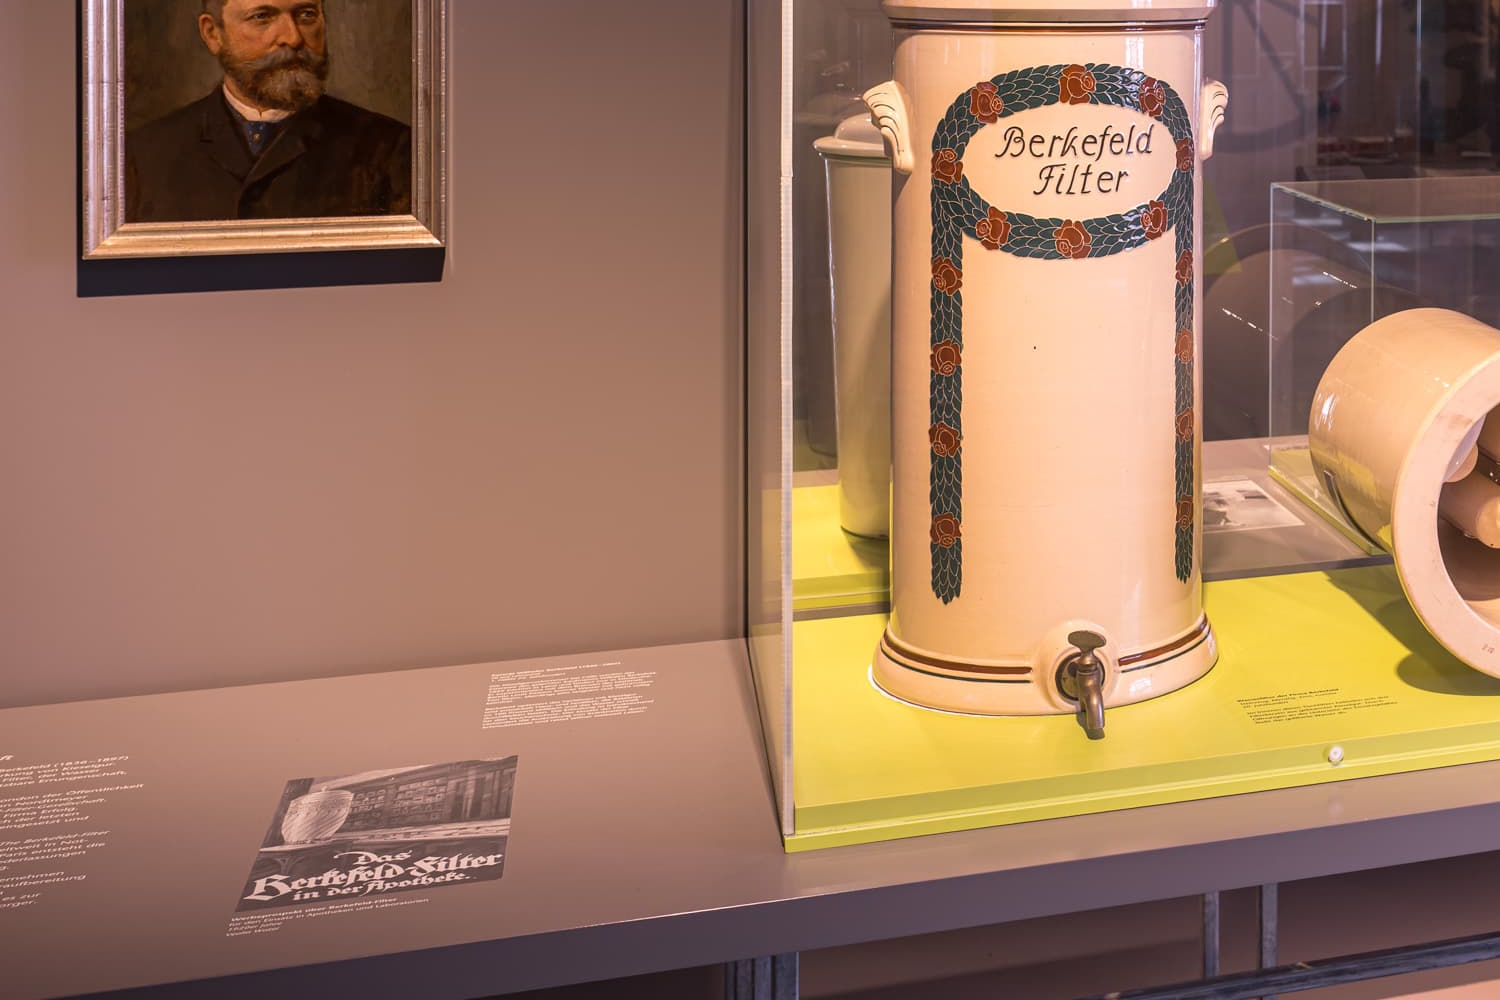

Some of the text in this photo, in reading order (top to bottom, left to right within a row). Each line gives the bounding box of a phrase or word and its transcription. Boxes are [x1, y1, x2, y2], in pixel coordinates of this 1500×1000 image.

[994, 123, 1155, 162] Berkefeld
[1032, 163, 1131, 196] Filter
[333, 849, 413, 866] Das
[293, 890, 320, 901] in
[326, 884, 365, 897] der
